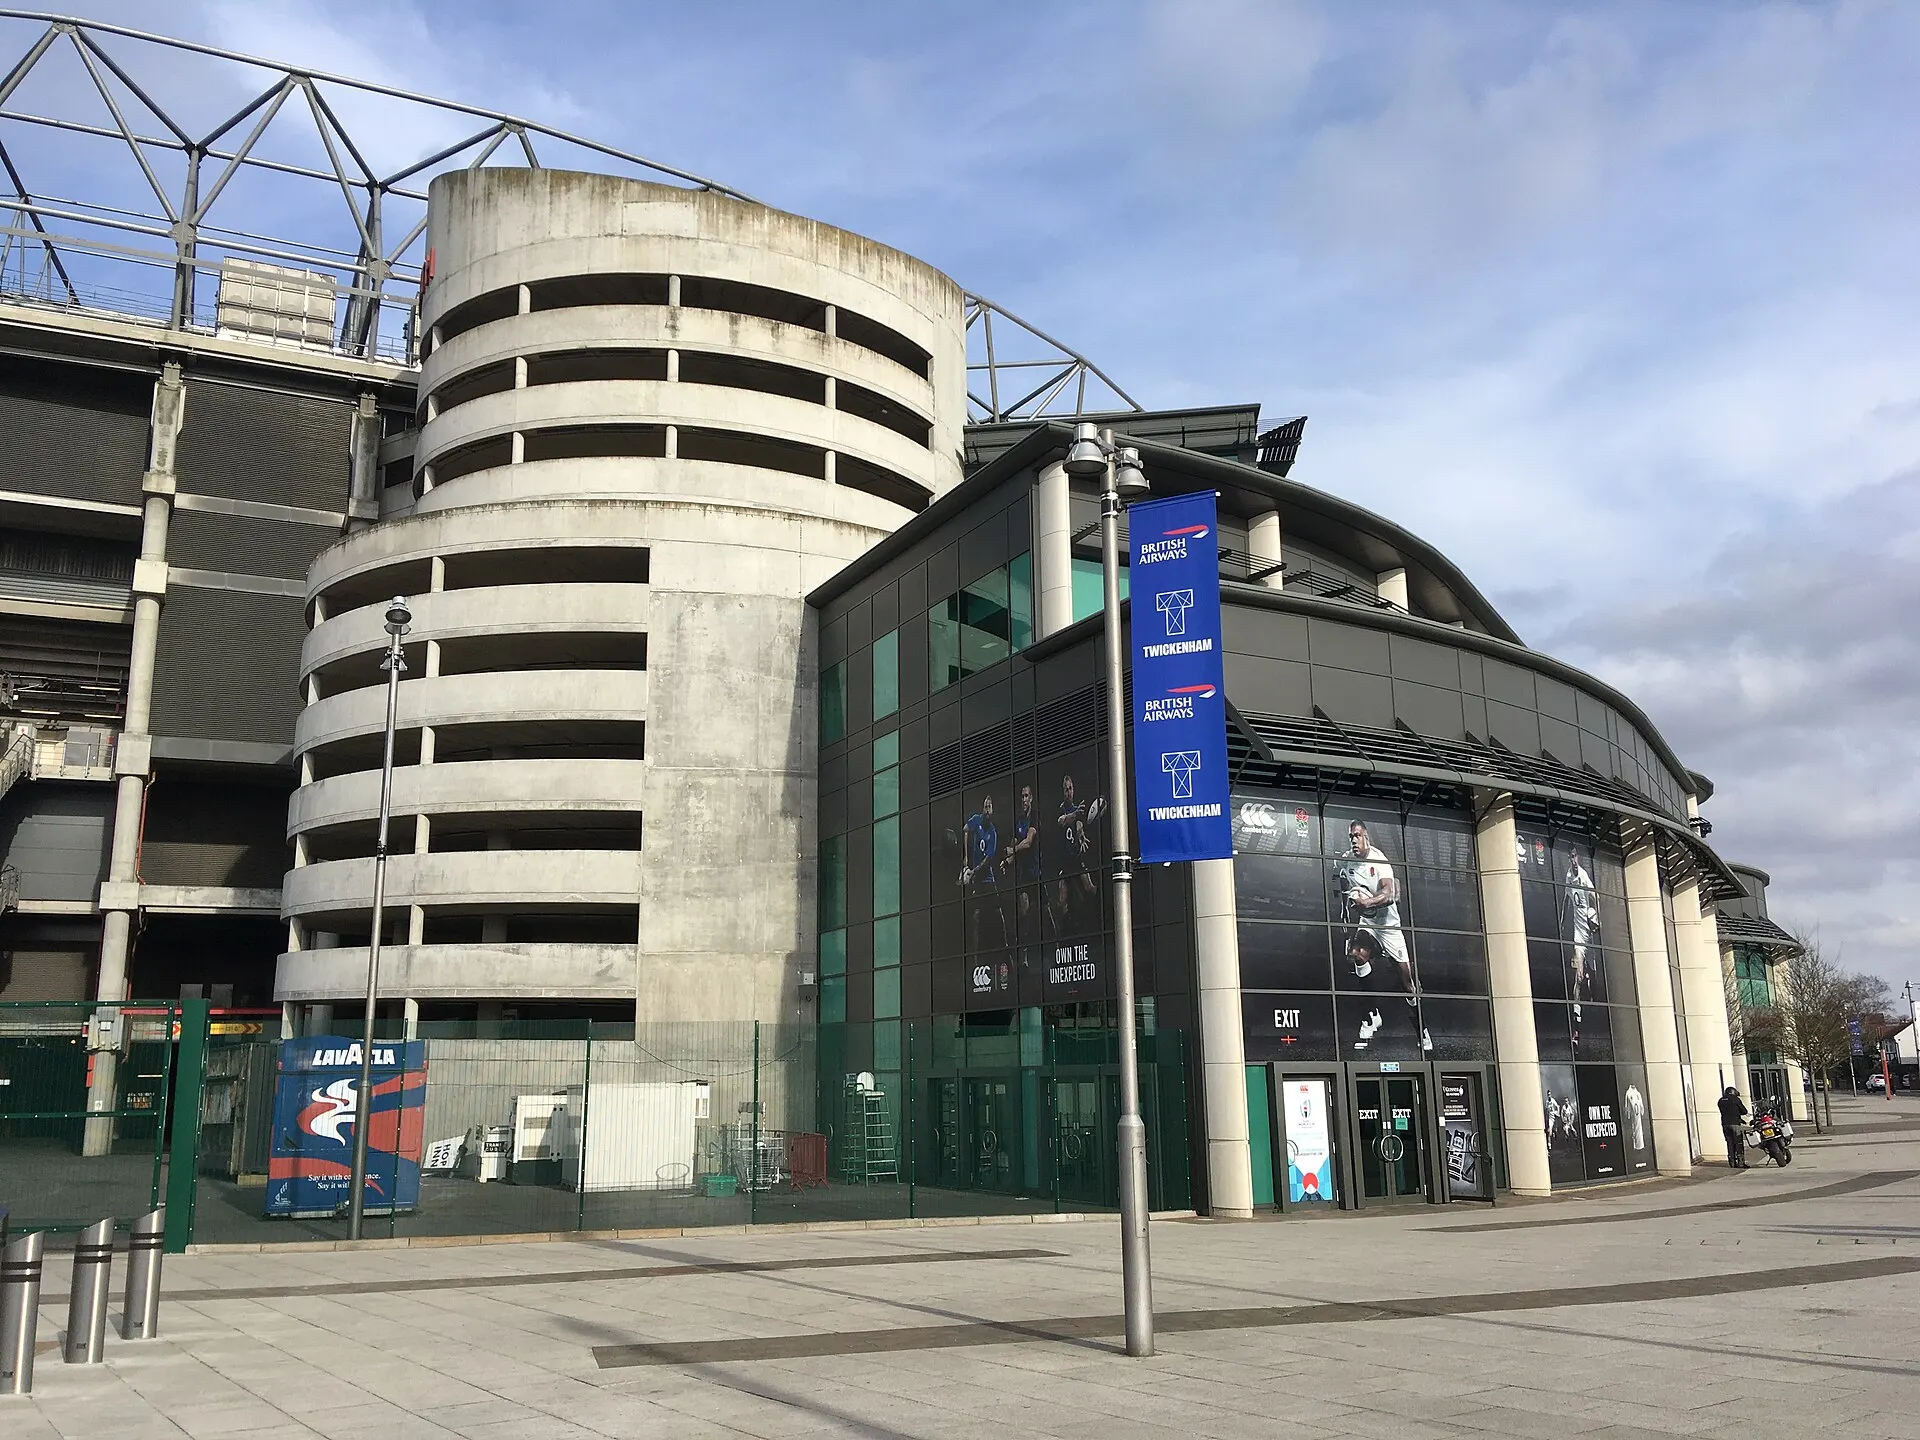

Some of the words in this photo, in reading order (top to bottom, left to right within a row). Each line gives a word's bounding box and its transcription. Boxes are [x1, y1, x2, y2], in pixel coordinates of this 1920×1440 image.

[1141, 537, 1186, 554] BRITISH
[1138, 548, 1188, 565] AIRWAYS
[1142, 638, 1213, 658] TWICKENHAM
[1145, 696, 1192, 711] BRITISH
[1143, 708, 1194, 722] AIRWAYS
[1148, 803, 1222, 821] TWICKENHAM
[1055, 947, 1072, 964] OWN
[1073, 944, 1089, 962] THE
[1049, 963, 1096, 984] UNEXPECTED
[1274, 1009, 1300, 1028] EXIT
[311, 1043, 396, 1066] LAVAZA
[1359, 1109, 1379, 1120] EXIT
[1392, 1108, 1412, 1119] EXIT
[1585, 1121, 1618, 1138] UNEXPECTED
[430, 1146, 442, 1168] INN
[440, 1143, 452, 1166] HOP
[308, 1174, 321, 1183] Say
[327, 1173, 343, 1181] with
[317, 1182, 330, 1191] Say
